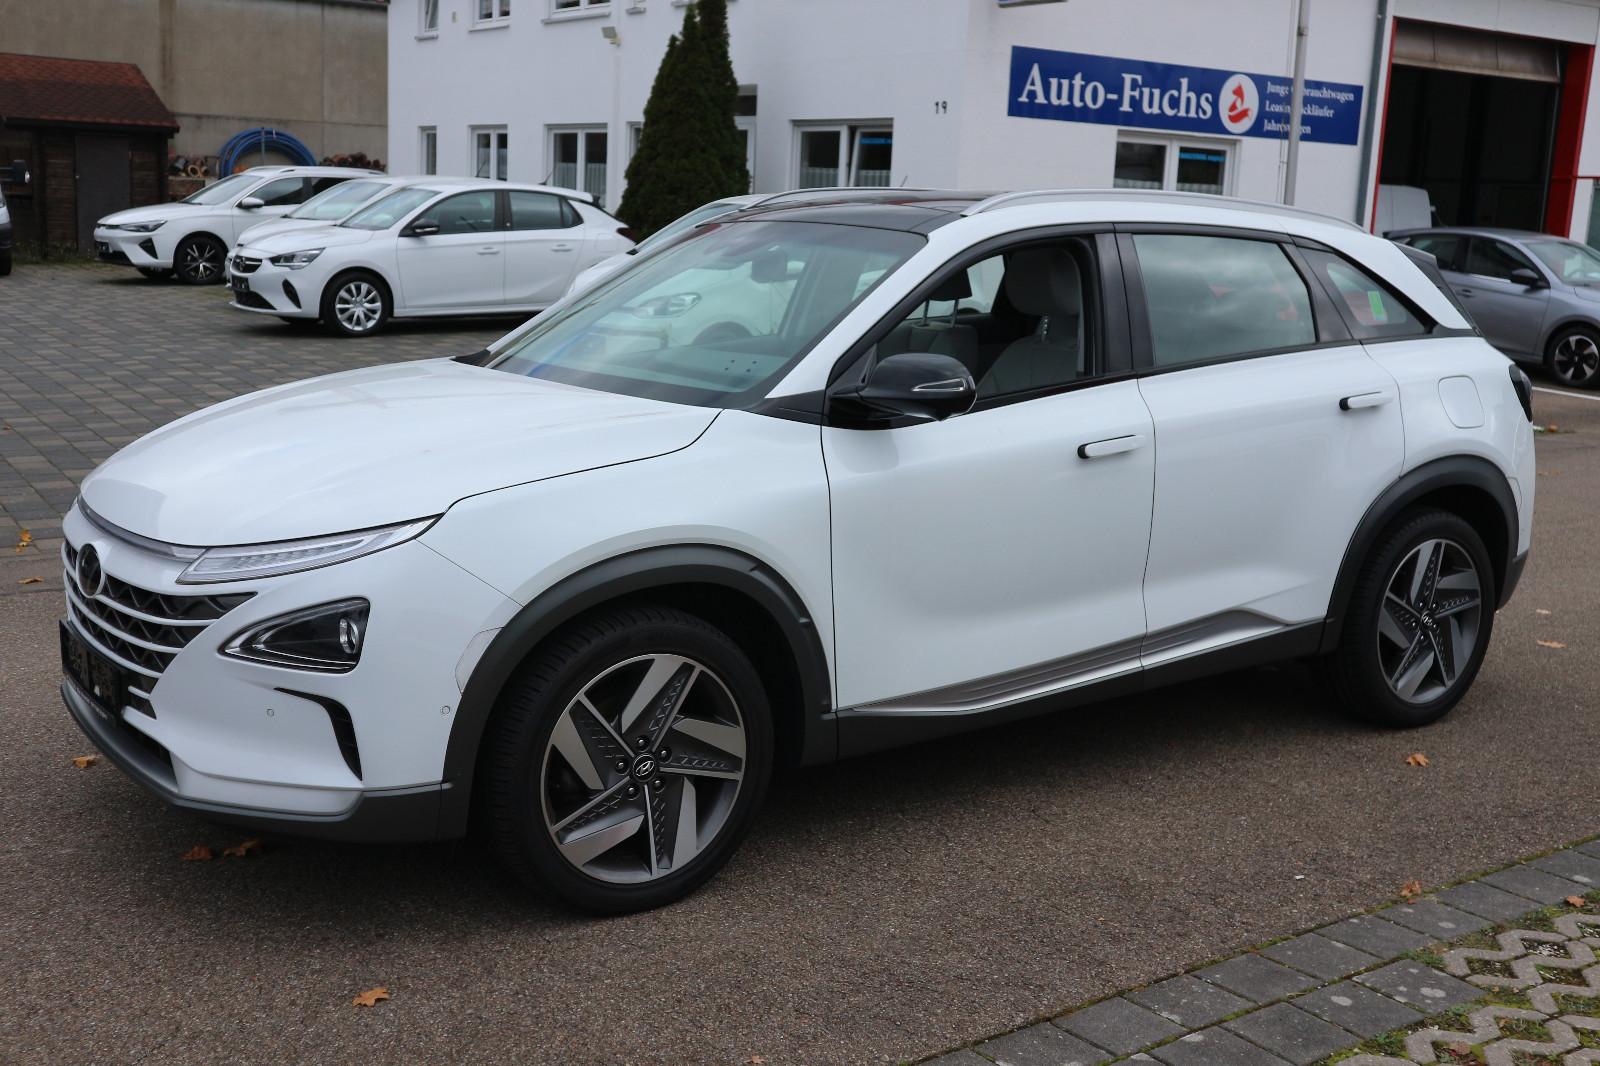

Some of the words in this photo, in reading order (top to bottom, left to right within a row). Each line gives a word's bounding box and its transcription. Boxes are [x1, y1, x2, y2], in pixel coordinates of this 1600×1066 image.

[1018, 63, 1212, 119] Auto-Fuchs
[1267, 81, 1288, 96] Junge
[934, 100, 948, 114] 19
